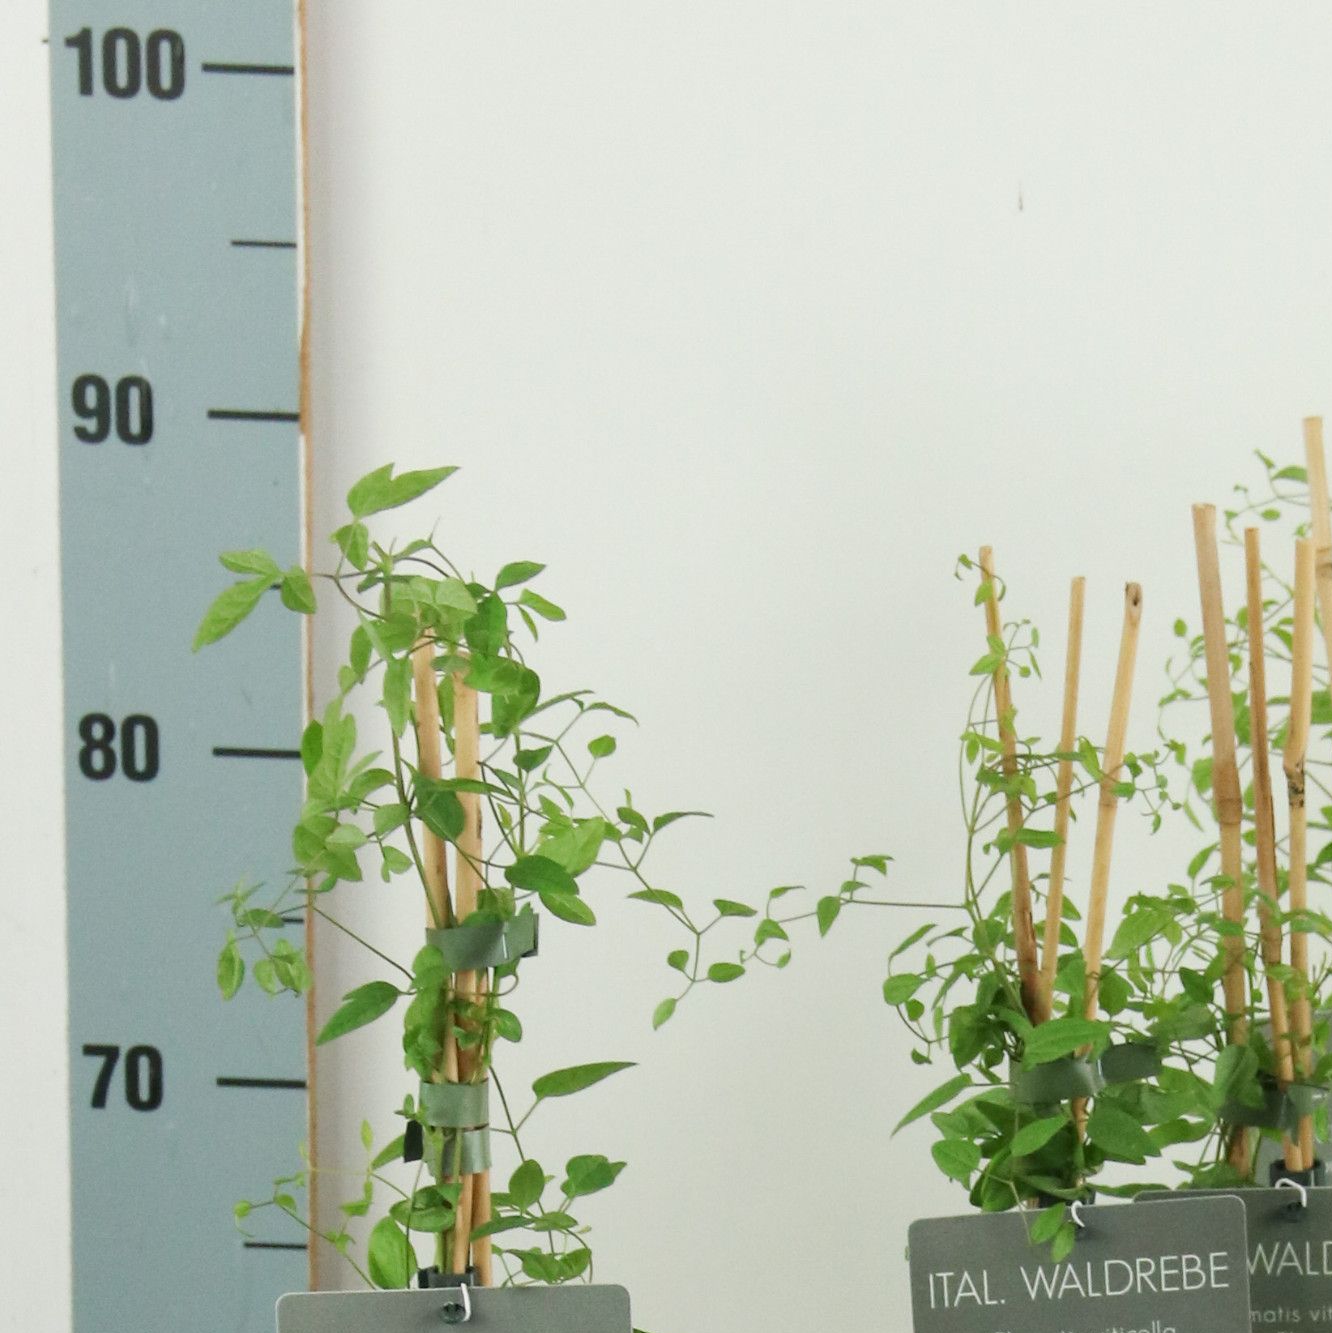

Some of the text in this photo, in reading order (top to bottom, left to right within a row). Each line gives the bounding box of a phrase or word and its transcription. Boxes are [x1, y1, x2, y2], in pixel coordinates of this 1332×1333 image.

[65, 28, 185, 100] 100
[71, 374, 154, 445] 90
[78, 713, 159, 782] 80
[81, 1044, 164, 1112] 70
[928, 1251, 1230, 1309] ITAL. WALDREBE
